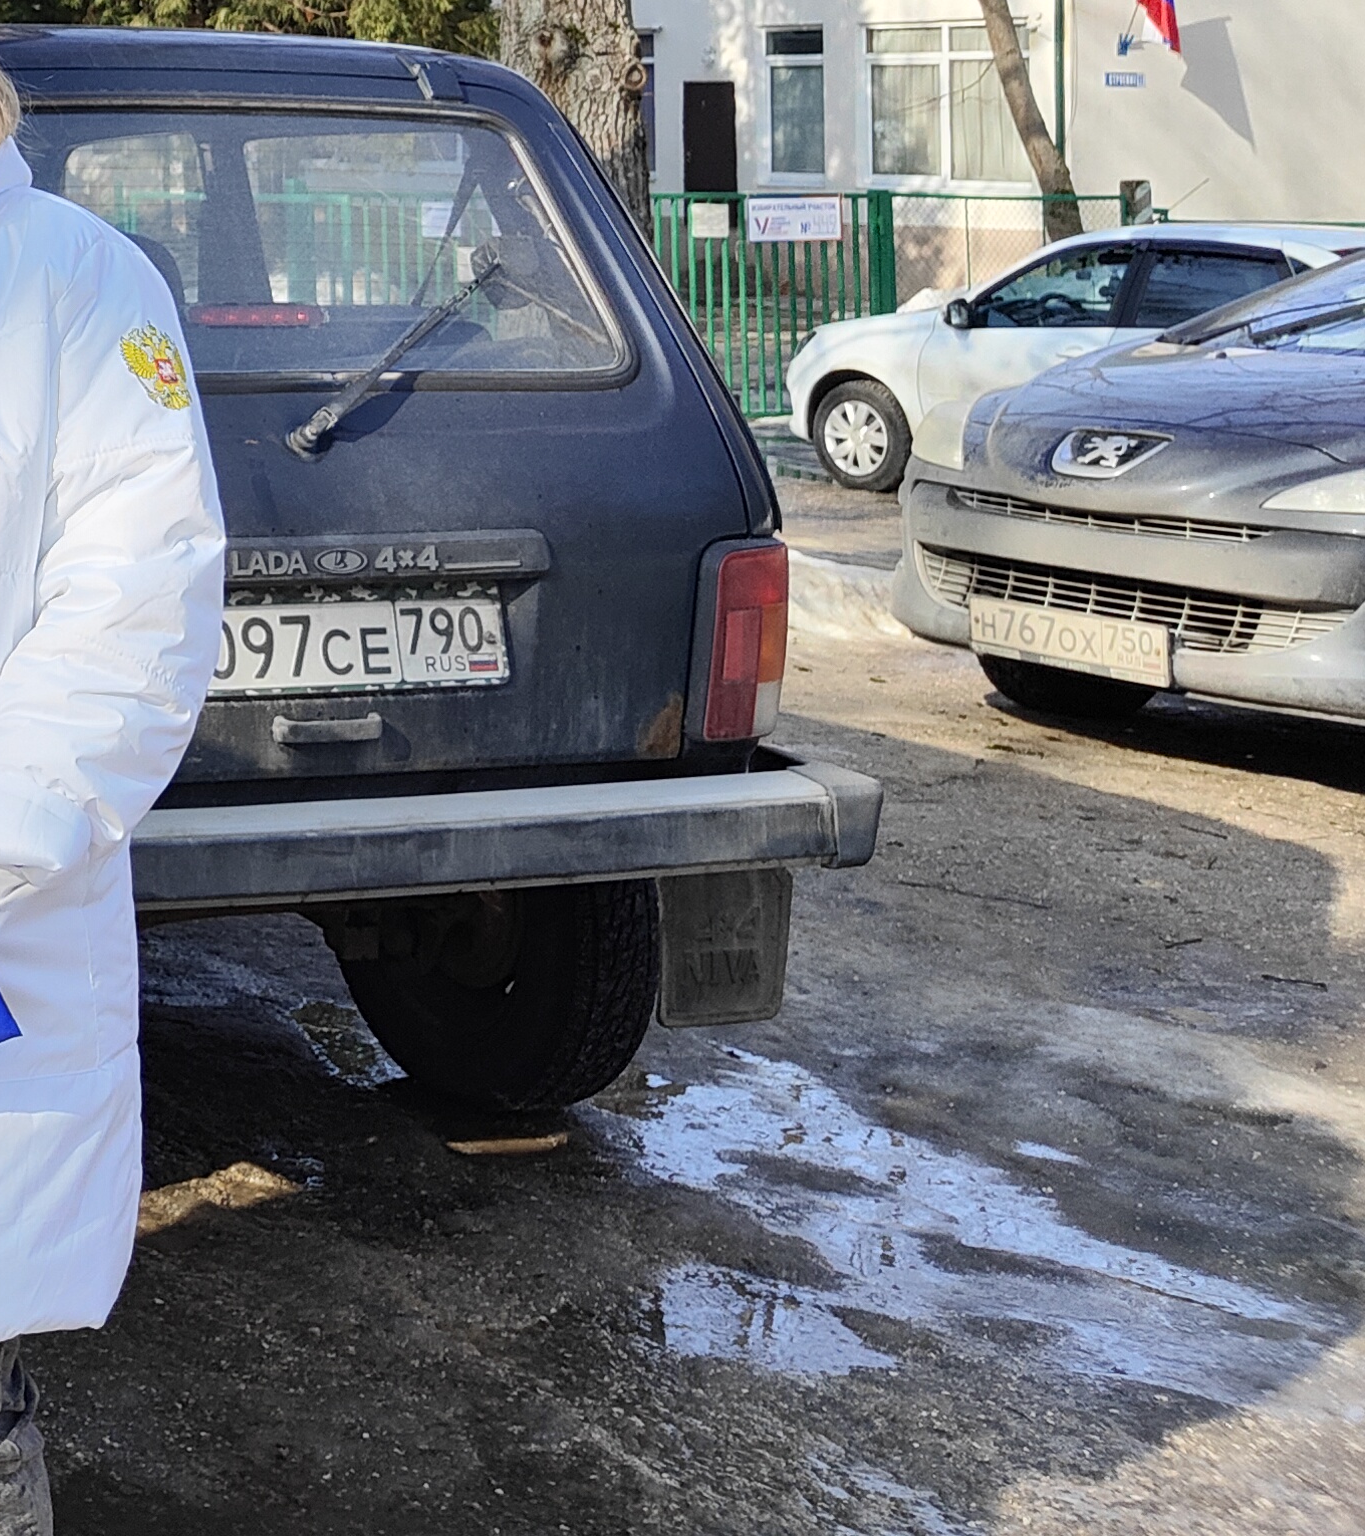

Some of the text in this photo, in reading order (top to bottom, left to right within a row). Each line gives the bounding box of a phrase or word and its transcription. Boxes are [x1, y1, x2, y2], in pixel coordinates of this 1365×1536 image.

[232, 550, 308, 577] LADA
[399, 606, 484, 655] 790
[981, 608, 1097, 659] Н767ОХ
[1104, 624, 1154, 656] 750
[425, 655, 467, 673] RUS
